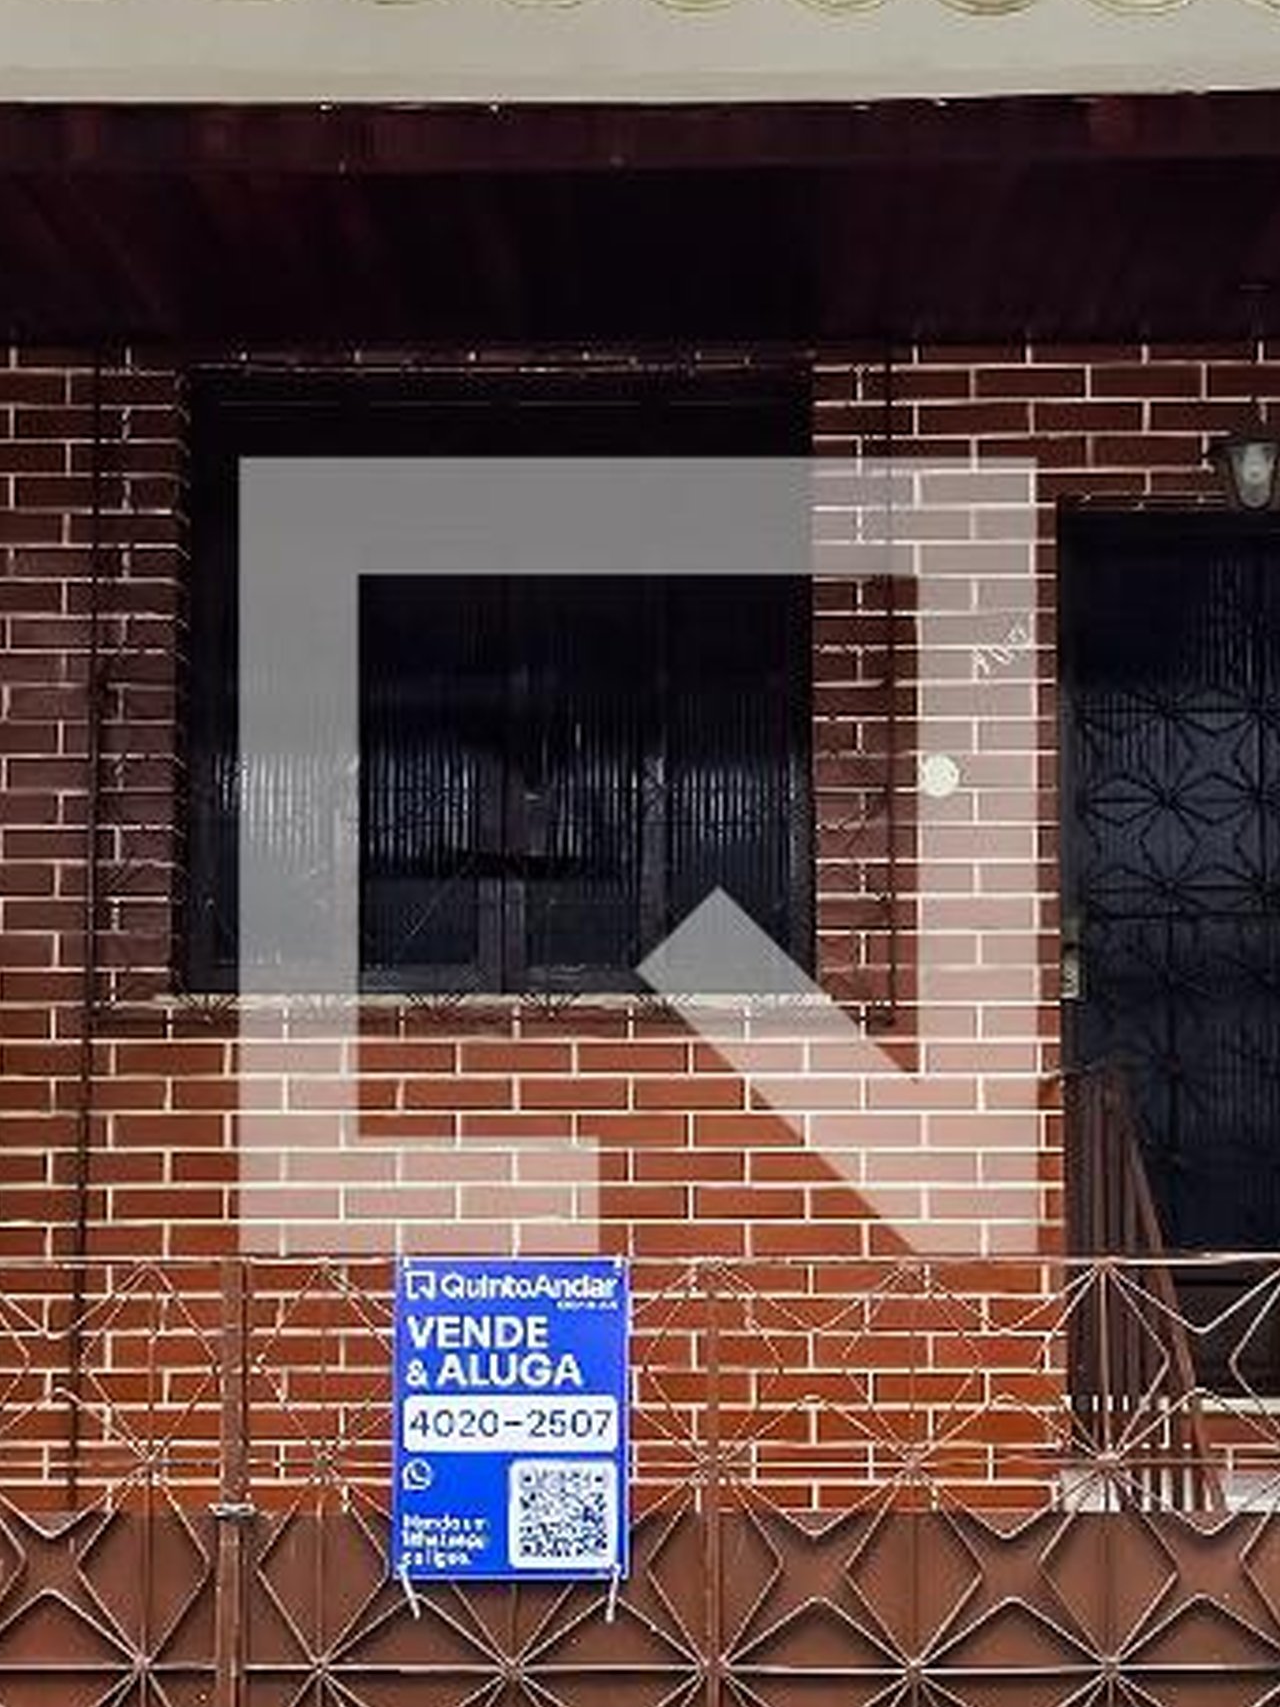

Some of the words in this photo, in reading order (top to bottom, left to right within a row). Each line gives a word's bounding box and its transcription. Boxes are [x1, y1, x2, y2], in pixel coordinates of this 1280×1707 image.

[440, 1271, 618, 1300] QuintoAndar
[406, 1315, 549, 1349] VENDE
[406, 1361, 428, 1387] &
[436, 1353, 584, 1387] ALUGA
[409, 1408, 613, 1438] 4020-2507
